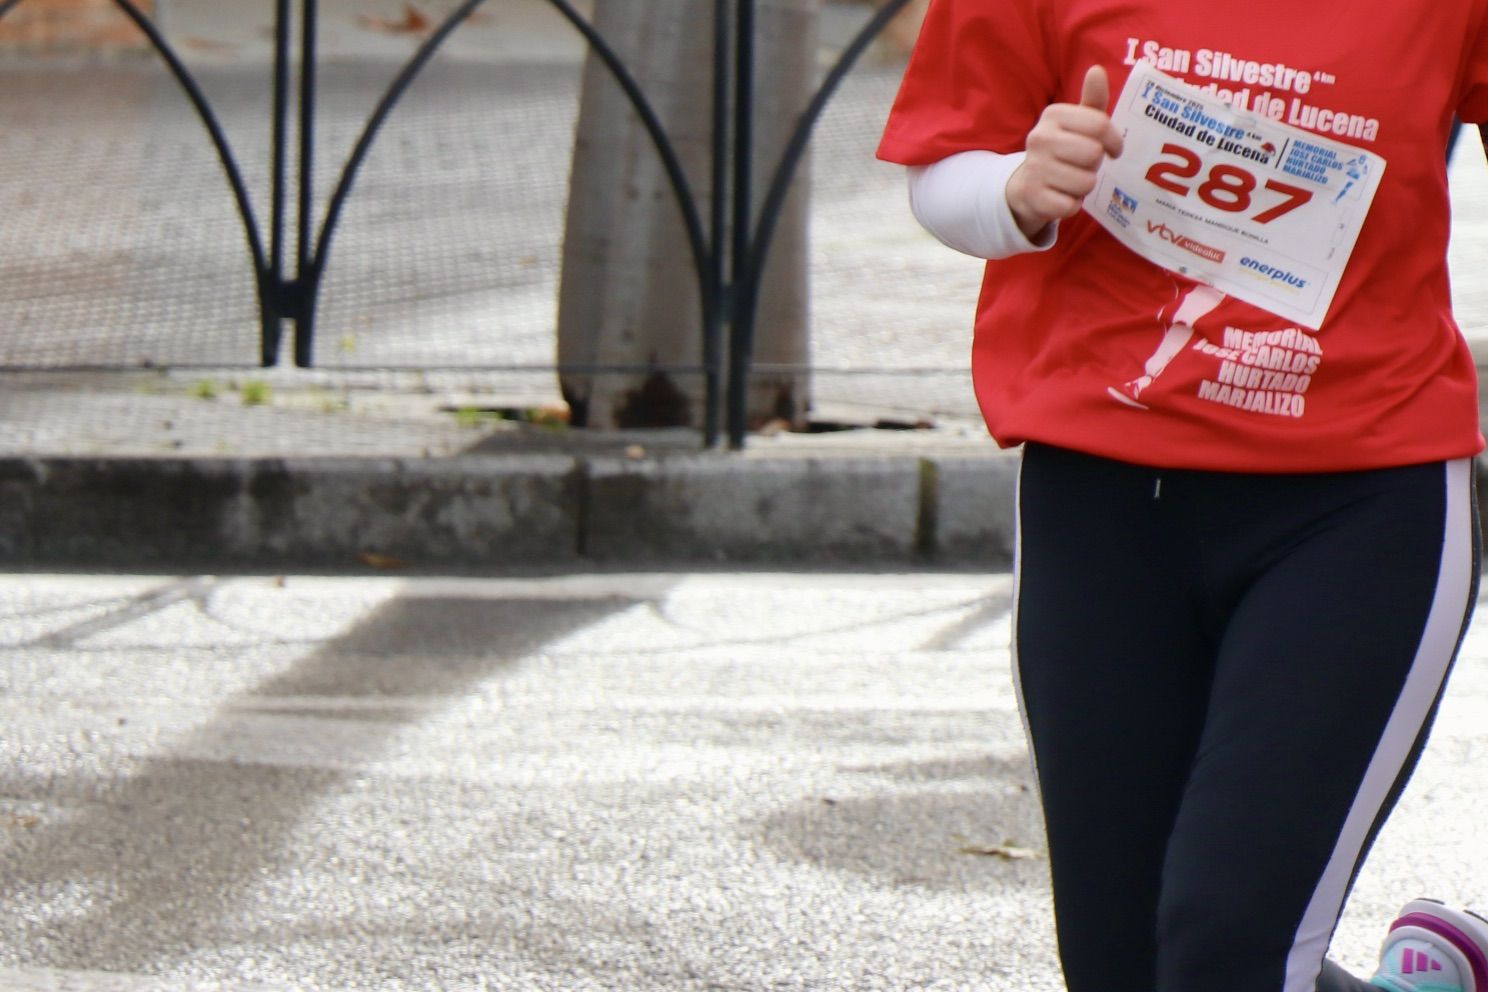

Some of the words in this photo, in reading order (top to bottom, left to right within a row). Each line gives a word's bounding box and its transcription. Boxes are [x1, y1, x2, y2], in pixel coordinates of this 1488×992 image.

[1124, 38, 1139, 64] I
[1142, 40, 1190, 74] San
[1195, 48, 1311, 94] Silvestre
[1321, 71, 1336, 84] km
[1141, 85, 1153, 99] I
[1152, 91, 1180, 114] San
[1181, 105, 1245, 140] Silvestre
[1253, 91, 1285, 122] de
[1288, 97, 1379, 142] Lucena
[1144, 104, 1196, 138] Ciudad
[1196, 129, 1216, 147] de
[1217, 137, 1269, 165] Lucena
[1294, 140, 1337, 159] MEMORIAL
[1311, 153, 1344, 171] CARLOS
[1144, 143, 1314, 225] 287
[1240, 256, 1307, 288] enerplus
[1224, 327, 1323, 355] MEMORIAL
[1242, 345, 1321, 374] CARLOS
[1218, 361, 1310, 393] HURTADO
[1198, 380, 1305, 417] MARJALIZO
